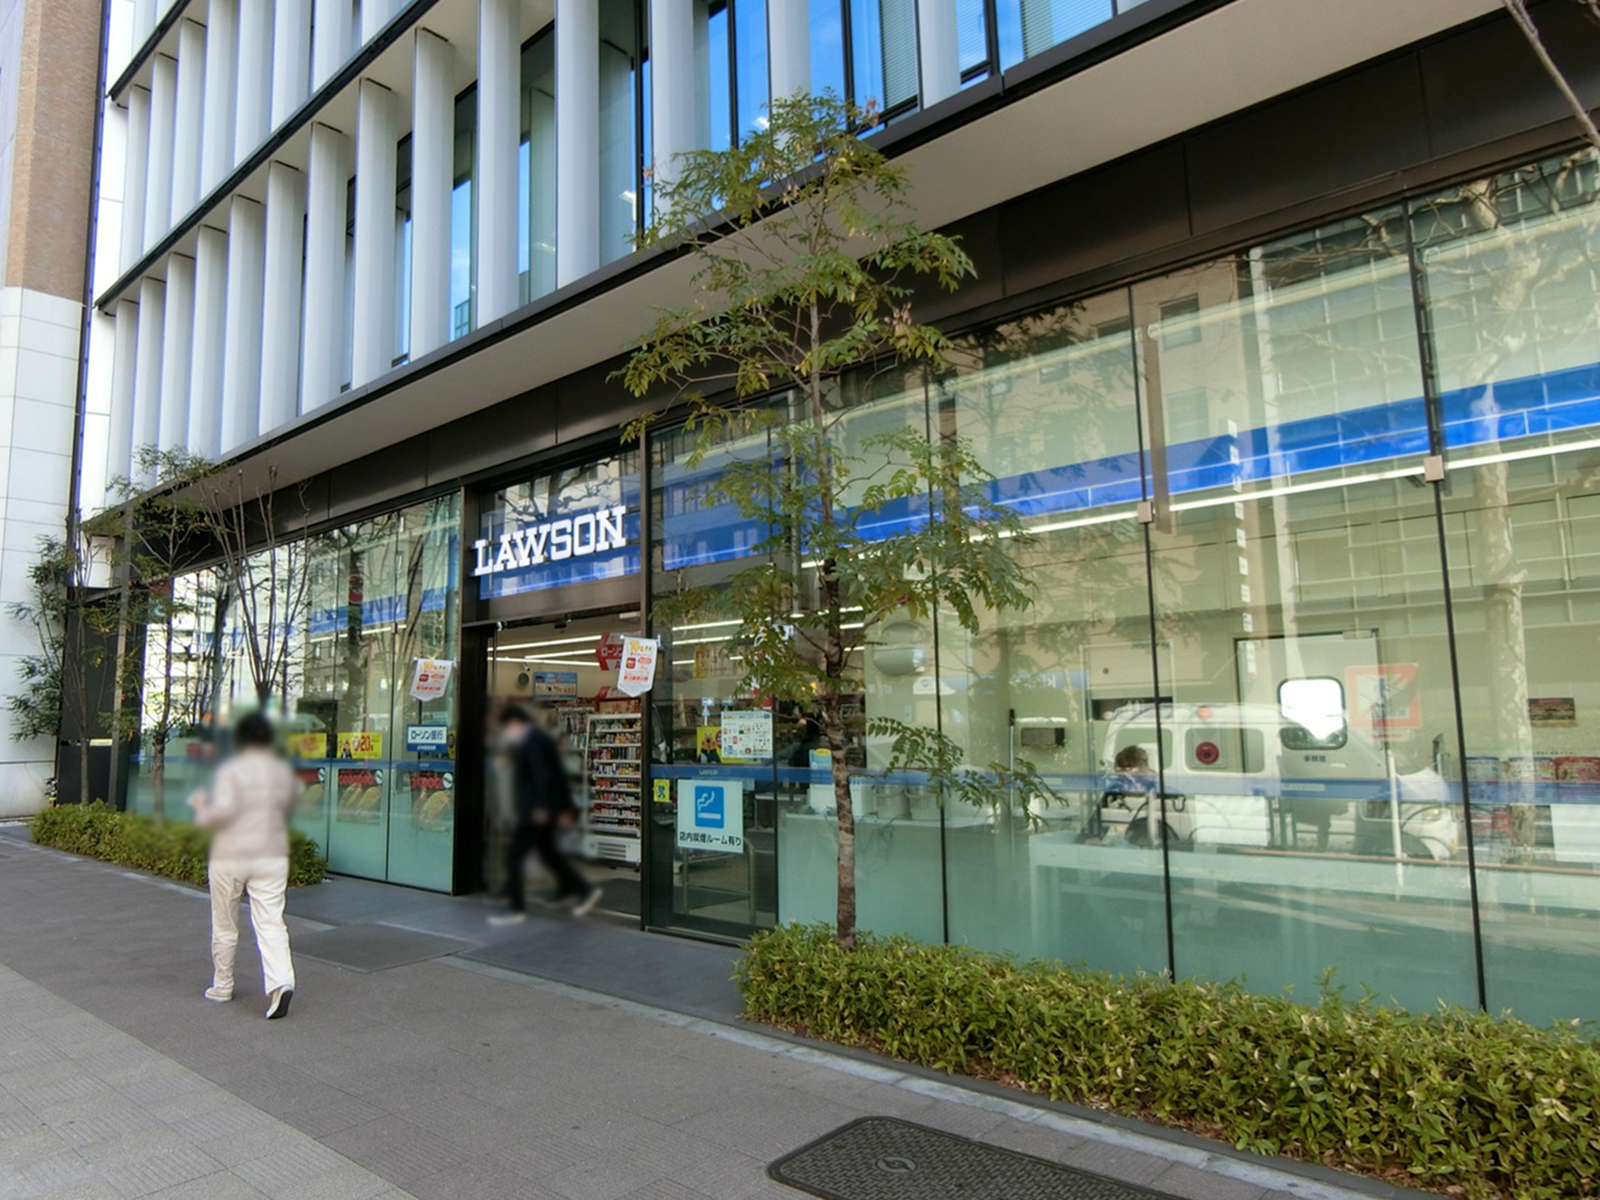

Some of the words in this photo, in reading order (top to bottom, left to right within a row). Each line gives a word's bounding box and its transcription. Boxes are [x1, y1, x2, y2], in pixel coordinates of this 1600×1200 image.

[474, 505, 626, 576] LAWSON
[411, 730, 444, 741] ローソン銀行
[679, 831, 742, 847] 店内喫煙ルーム有り
